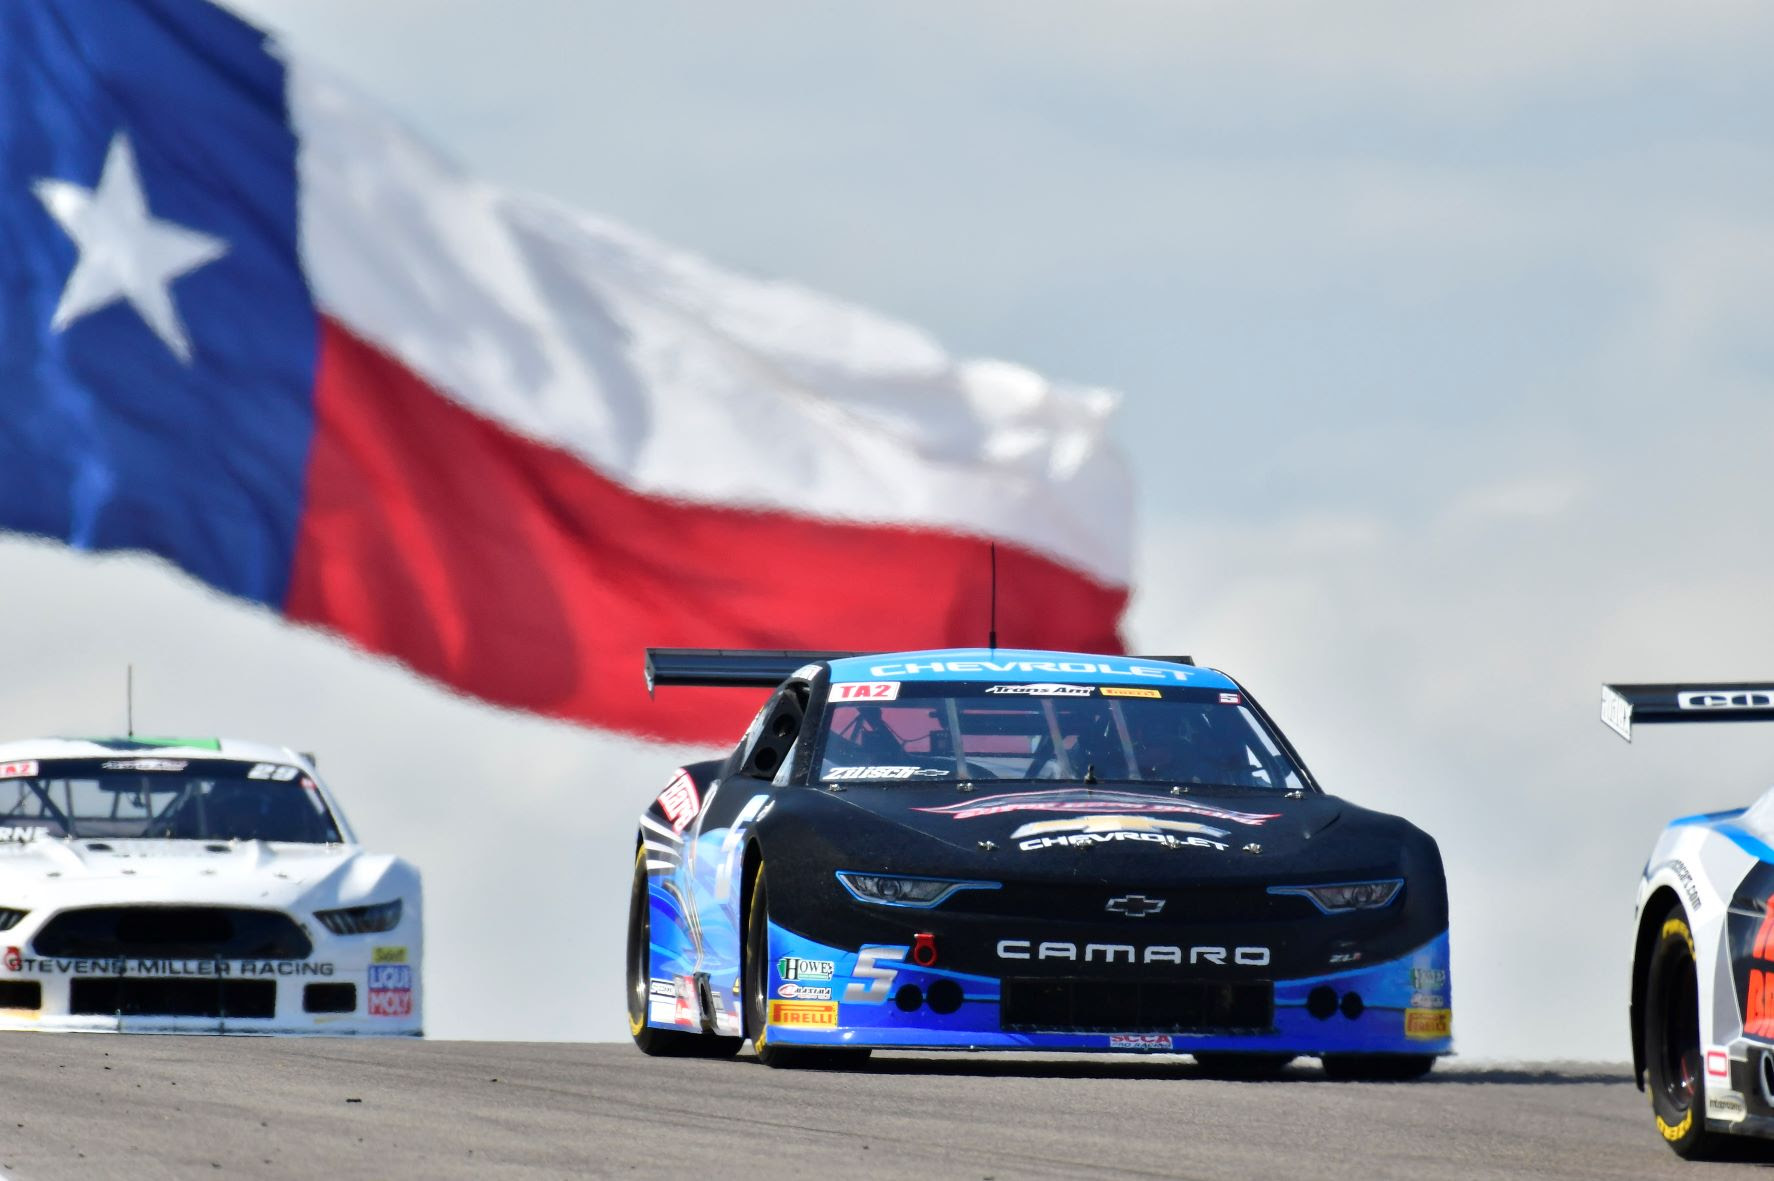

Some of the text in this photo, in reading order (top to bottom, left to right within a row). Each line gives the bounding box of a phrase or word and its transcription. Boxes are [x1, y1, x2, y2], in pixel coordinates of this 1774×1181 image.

[870, 661, 1194, 682] CHEVROLET
[840, 684, 892, 699] TA2
[1219, 693, 1239, 704] 5
[1019, 832, 1231, 851] CHEVROLET
[997, 940, 1271, 965] CAMARO
[241, 961, 334, 976] RACING
[370, 966, 409, 988] LIQUI
[844, 944, 909, 1005] 5
[371, 991, 411, 1014] MOLY
[773, 1003, 833, 1024] PIRELLI
